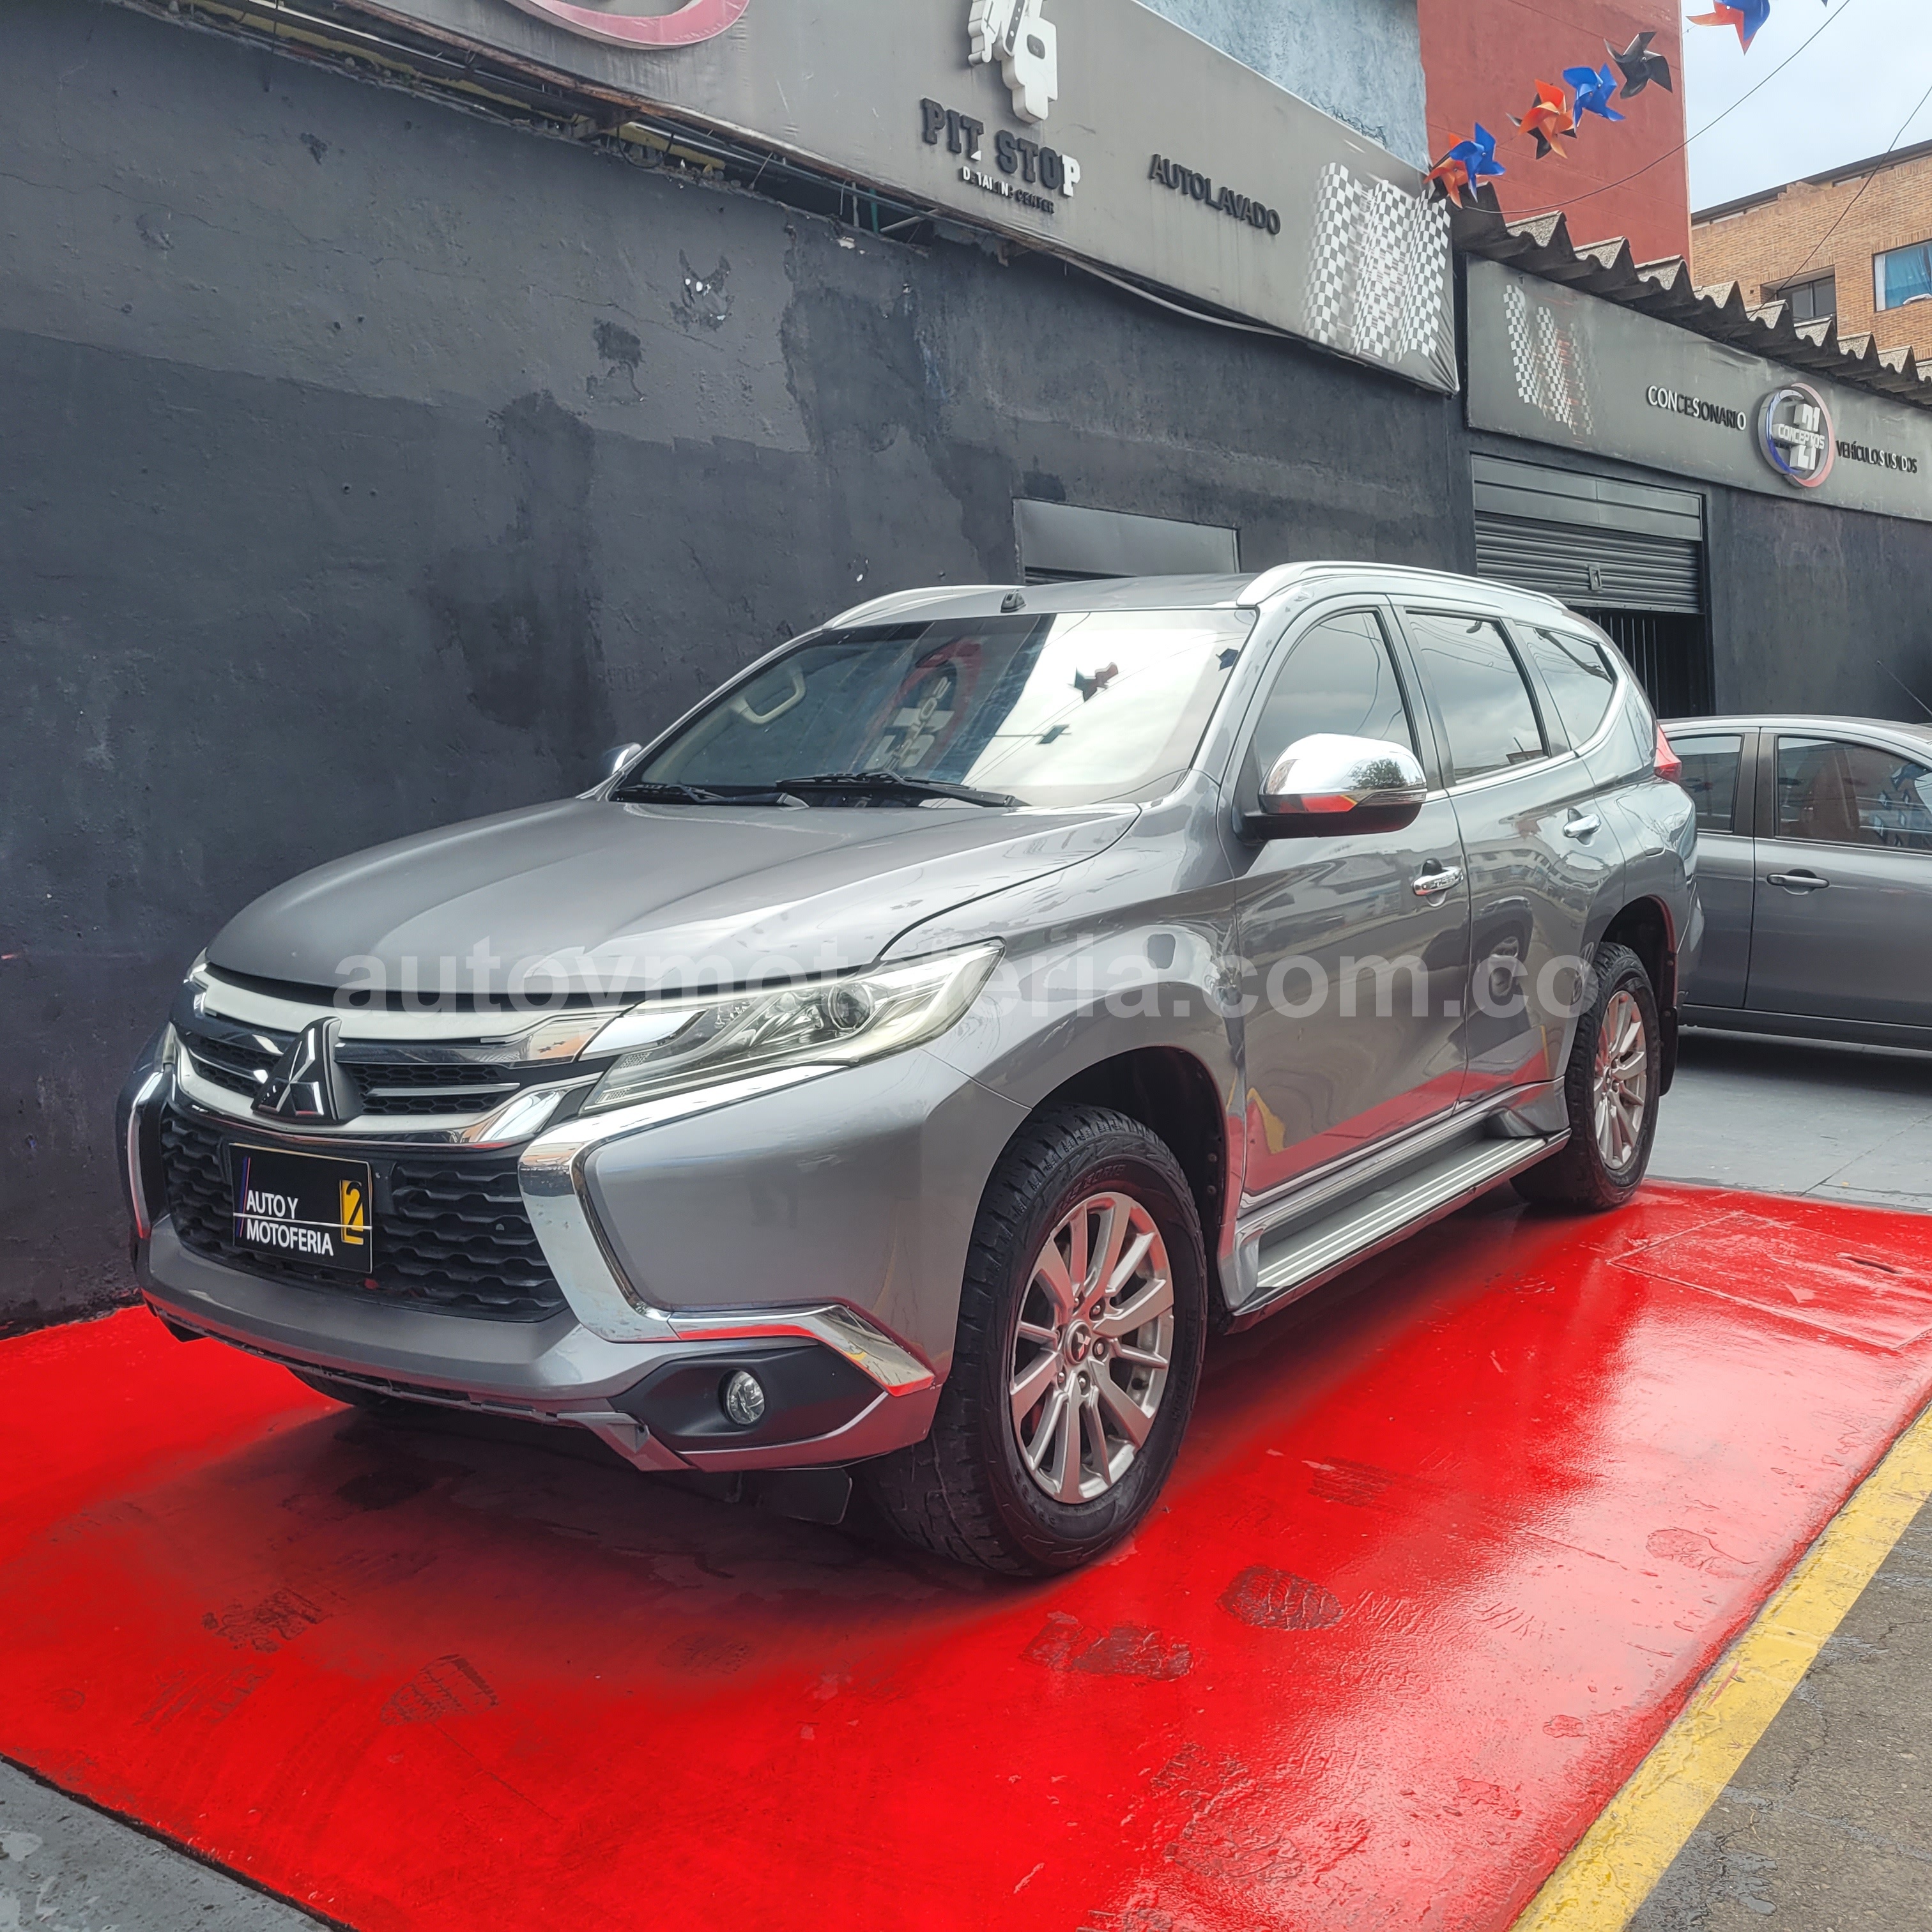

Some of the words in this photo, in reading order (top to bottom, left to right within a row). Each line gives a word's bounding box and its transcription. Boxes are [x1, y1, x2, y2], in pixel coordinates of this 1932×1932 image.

[921, 97, 984, 160] PIT
[995, 129, 1081, 197] STOP
[1149, 153, 1281, 234] AUTOLAVADO
[1646, 385, 1747, 431] CONCESIONARIO
[1778, 423, 1825, 450] CONCEPTOS
[1836, 440, 1885, 466] VEHÍCULOS
[247, 1190, 286, 1217] AUTO
[287, 1196, 298, 1219] Y
[247, 1218, 334, 1257] MOTOFERIA
